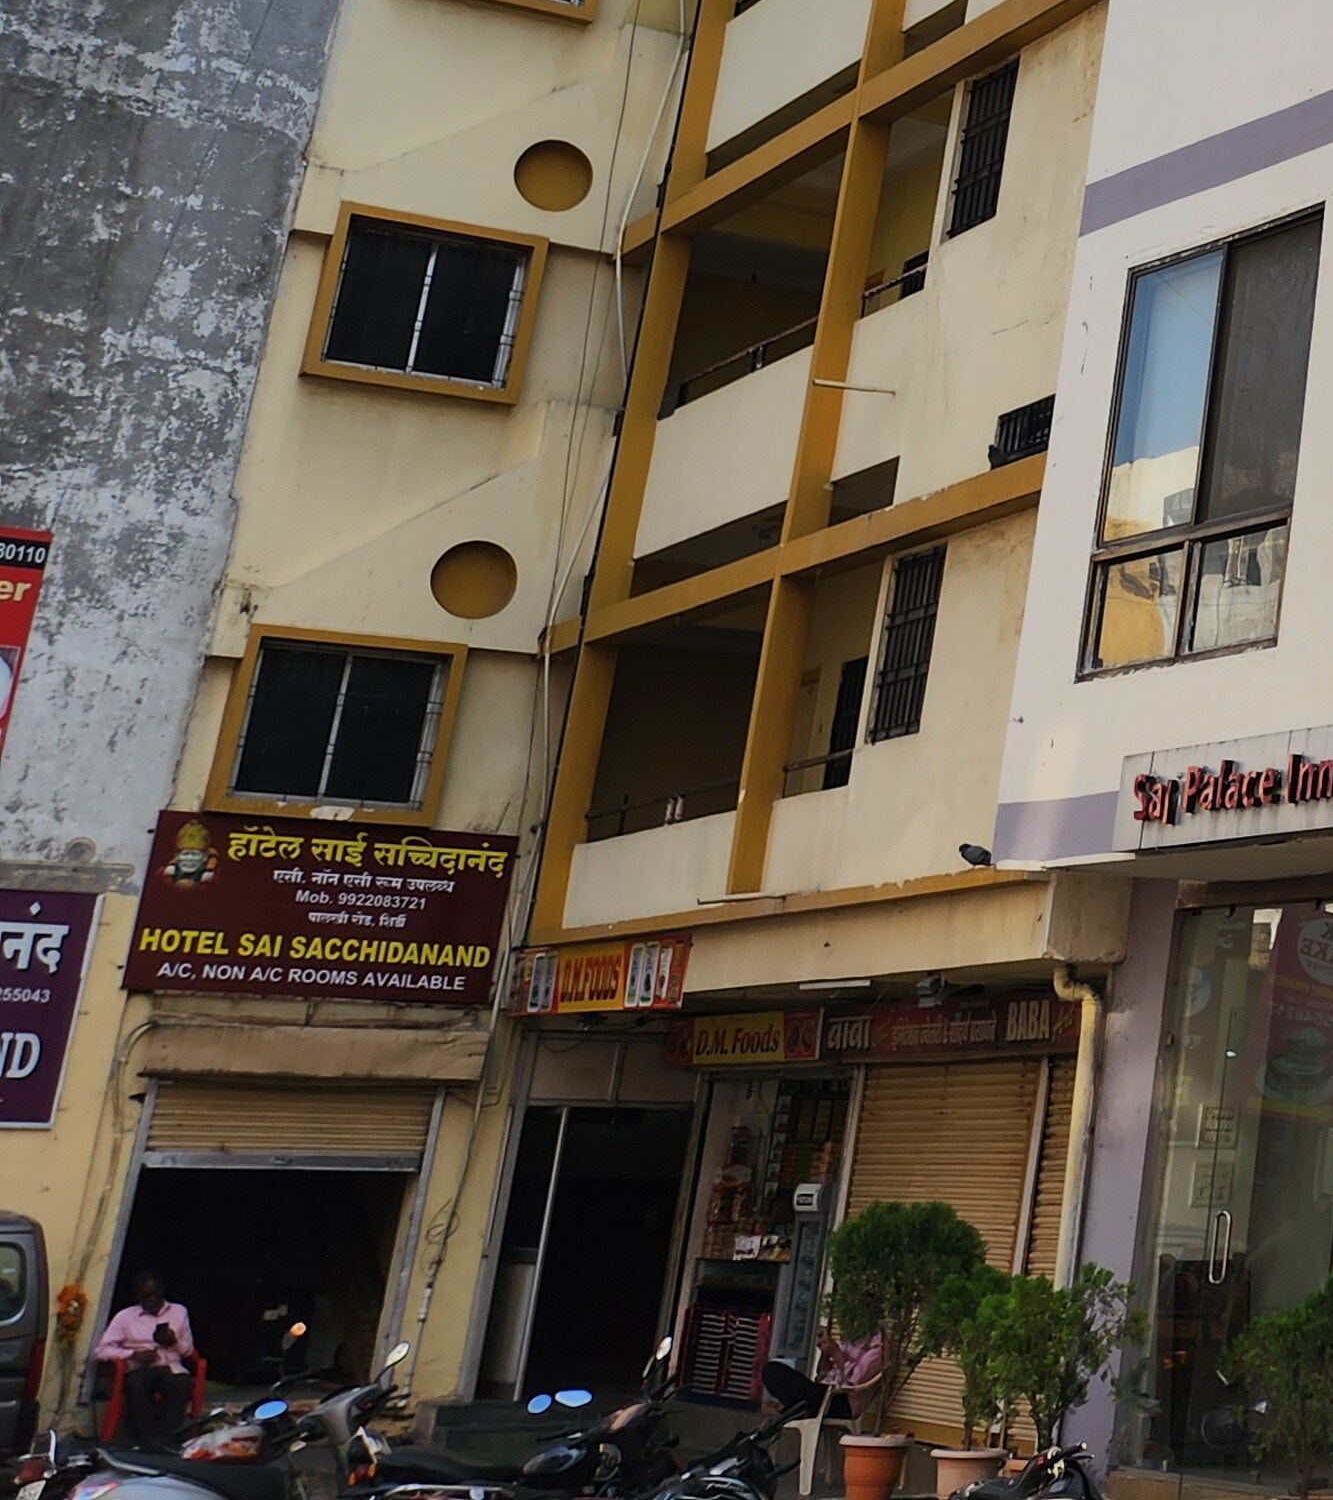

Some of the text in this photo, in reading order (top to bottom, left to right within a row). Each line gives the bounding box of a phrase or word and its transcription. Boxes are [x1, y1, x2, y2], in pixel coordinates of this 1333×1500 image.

[1133, 773, 1178, 826] Sai
[1182, 759, 1281, 814] Palace
[228, 826, 508, 878] हॉटेल साई सच्चिदानंद
[311, 869, 339, 887] नॉन
[295, 890, 427, 910] Mob. 9922083721
[139, 928, 491, 968] HOTEL SAI SACCHIDANAND
[156, 962, 466, 991] A/C, NON A/C ROOMS AVAILABLE
[827, 1015, 873, 1050] बाबा
[1006, 1000, 1050, 1041] BABA
[696, 1024, 781, 1056] D.M. Foods
